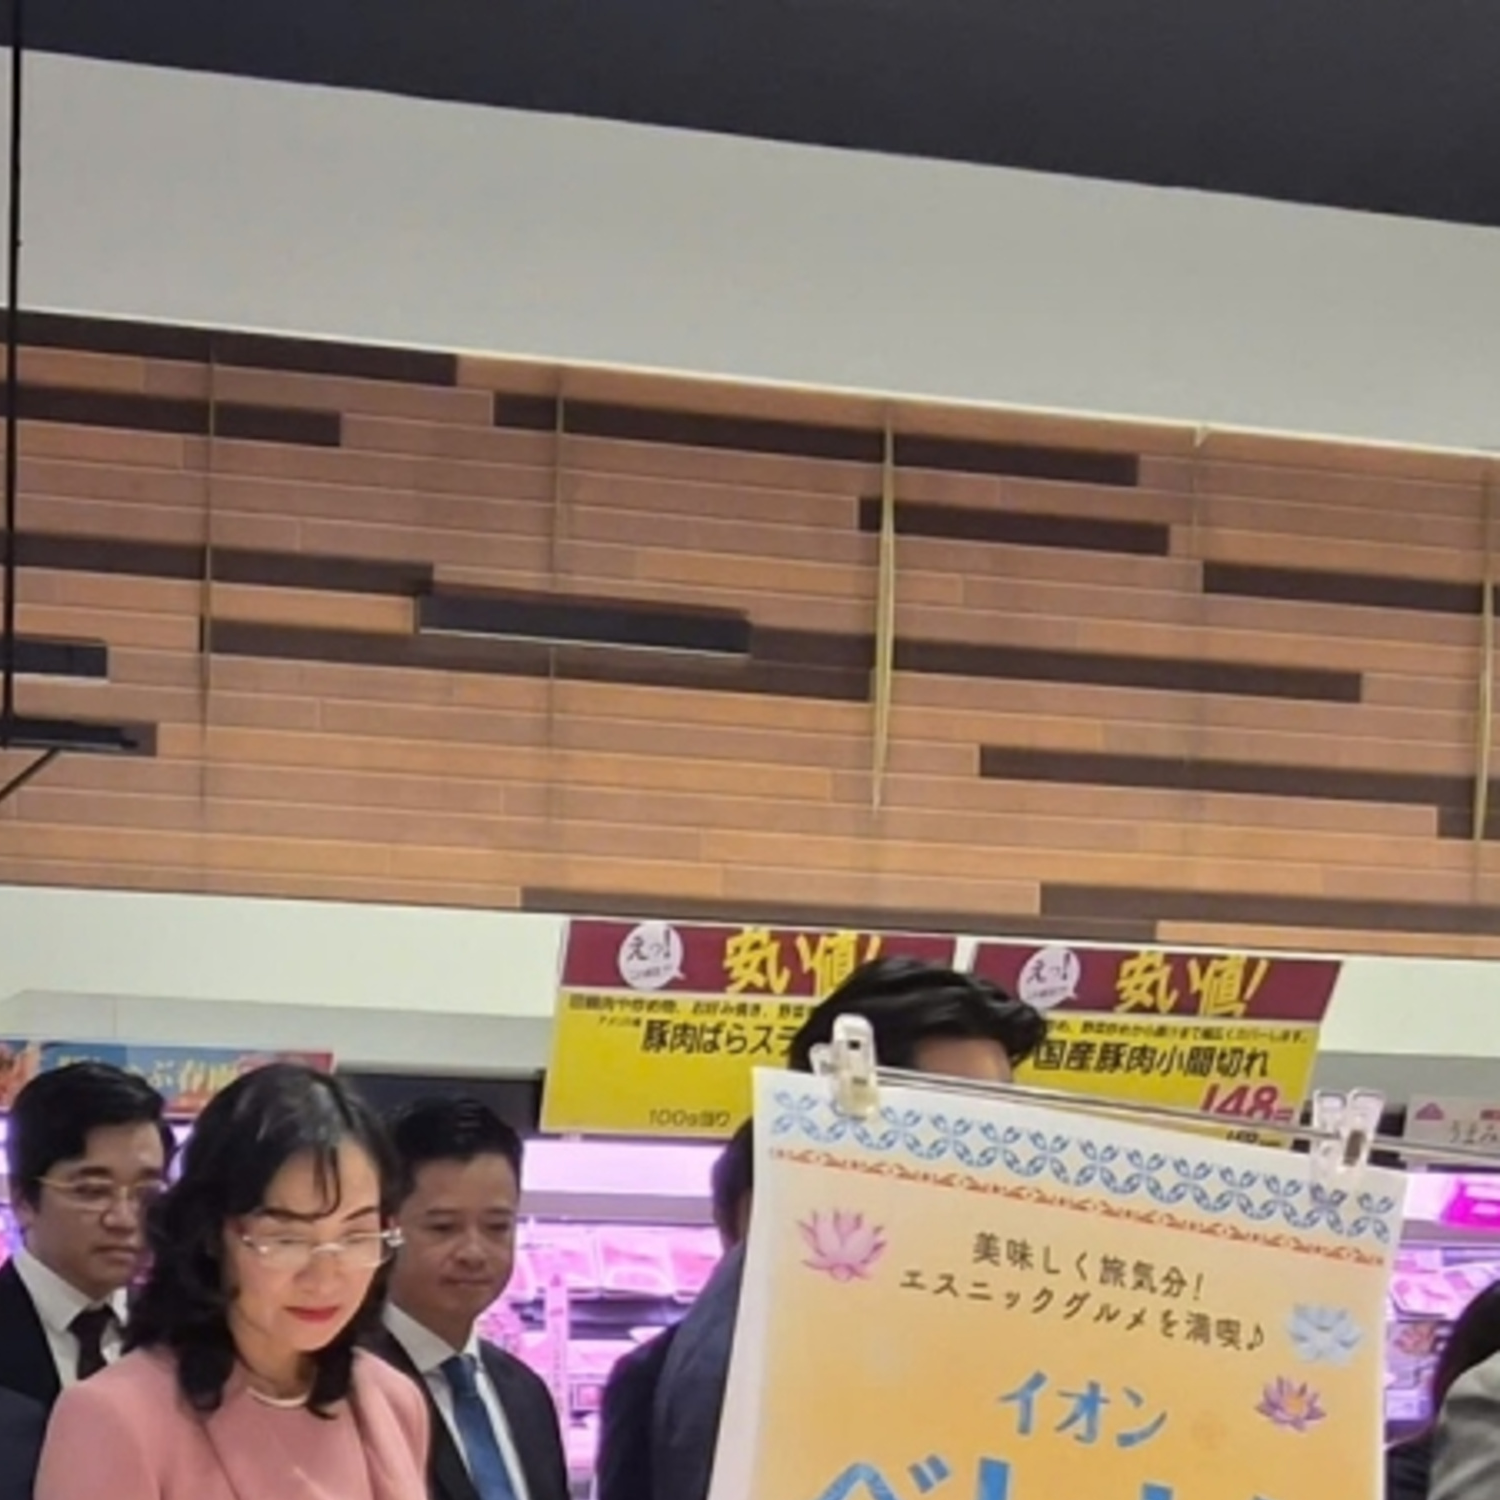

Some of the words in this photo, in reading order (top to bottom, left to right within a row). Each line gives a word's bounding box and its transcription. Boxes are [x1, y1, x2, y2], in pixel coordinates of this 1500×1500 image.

[1113, 950, 1270, 1018] 安い値!
[1033, 1040, 1269, 1079] 国産豚肉小間切れ
[973, 1230, 1206, 1301] 美味しく旅気分!
[998, 1370, 1168, 1449] イオン
